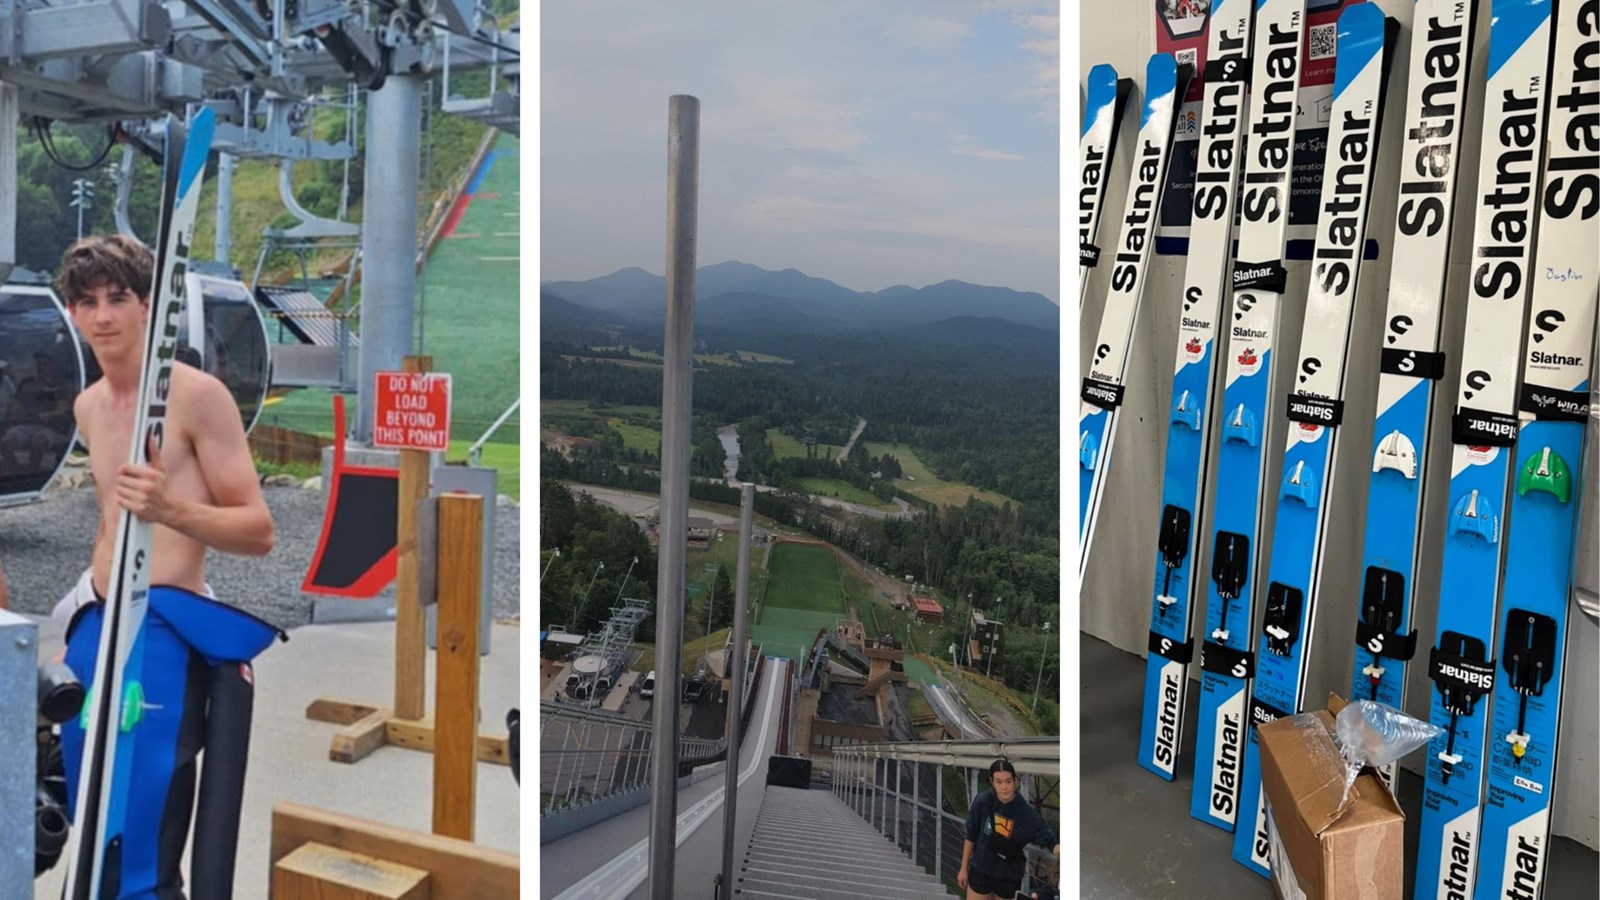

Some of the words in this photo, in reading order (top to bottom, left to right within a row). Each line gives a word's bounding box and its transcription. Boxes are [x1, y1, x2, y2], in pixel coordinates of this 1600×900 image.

[1305, 69, 1325, 77] Learn
[1194, 29, 1244, 221] Slatnr
[1243, 22, 1299, 223] Slatnar
[1398, 16, 1463, 237] Slatnar
[1171, 182, 1193, 190] Secure
[1300, 174, 1313, 183] the
[1315, 110, 1371, 296] Slatnar
[1474, 88, 1538, 300] Slatnar
[1111, 140, 1161, 294] Slatnar
[389, 375, 408, 393] DO
[410, 375, 434, 394] NOT
[395, 393, 428, 411] LOAD
[377, 426, 404, 444] THIS
[407, 428, 446, 446] POINT
[386, 410, 437, 429] BEYOND
[1156, 674, 1178, 766] Slatnar
[1212, 714, 1239, 815] Slatnar
[1490, 784, 1526, 804] Improving
